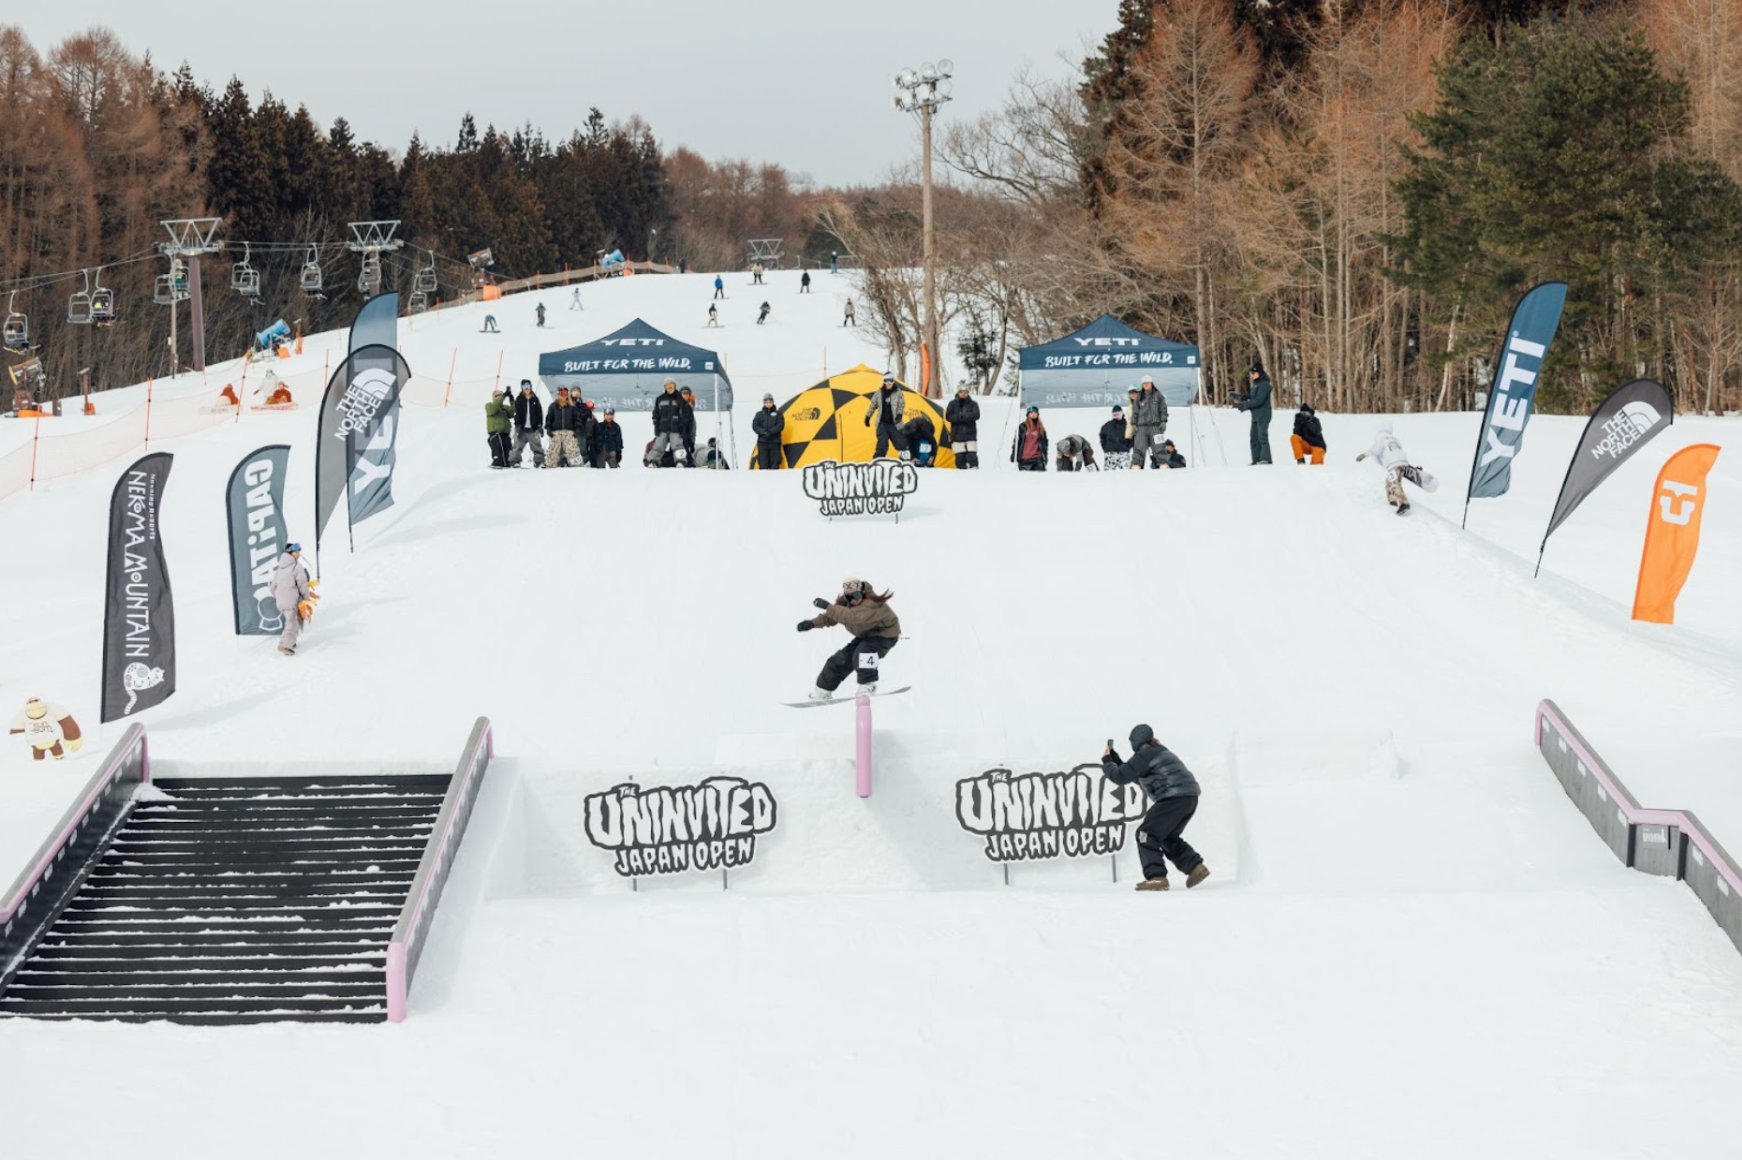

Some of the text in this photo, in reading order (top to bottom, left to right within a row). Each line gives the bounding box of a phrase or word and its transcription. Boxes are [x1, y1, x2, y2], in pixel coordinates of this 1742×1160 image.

[601, 338, 665, 347] YETI
[1074, 337, 1140, 346] YETI
[564, 361, 602, 372] BUILT
[603, 359, 630, 370] FOR
[632, 358, 656, 369] THE
[1045, 356, 1083, 367] BUILT
[1085, 354, 1111, 365] FOR
[1113, 353, 1138, 364] THE
[336, 384, 361, 412] THE
[1479, 335, 1546, 467] YETI
[334, 390, 371, 441] NORTH
[353, 397, 382, 433] FACE
[1601, 409, 1628, 435] THE
[1591, 419, 1635, 460] NORTH
[1610, 429, 1642, 458] FACE
[804, 460, 917, 499] UNINVITED
[821, 495, 904, 516] JAPAN OPEN
[124, 470, 150, 656] NEKOMA MOUNTAIN
[866, 655, 875, 666] 4
[619, 786, 637, 798] THE
[990, 772, 1008, 783] THE
[586, 777, 775, 848] UNINVITED
[958, 766, 1145, 832] UNINVITED
[617, 836, 753, 874] JAPAN OPEN
[987, 830, 1060, 859] JAPAN
[1065, 824, 1123, 854] OPEN
